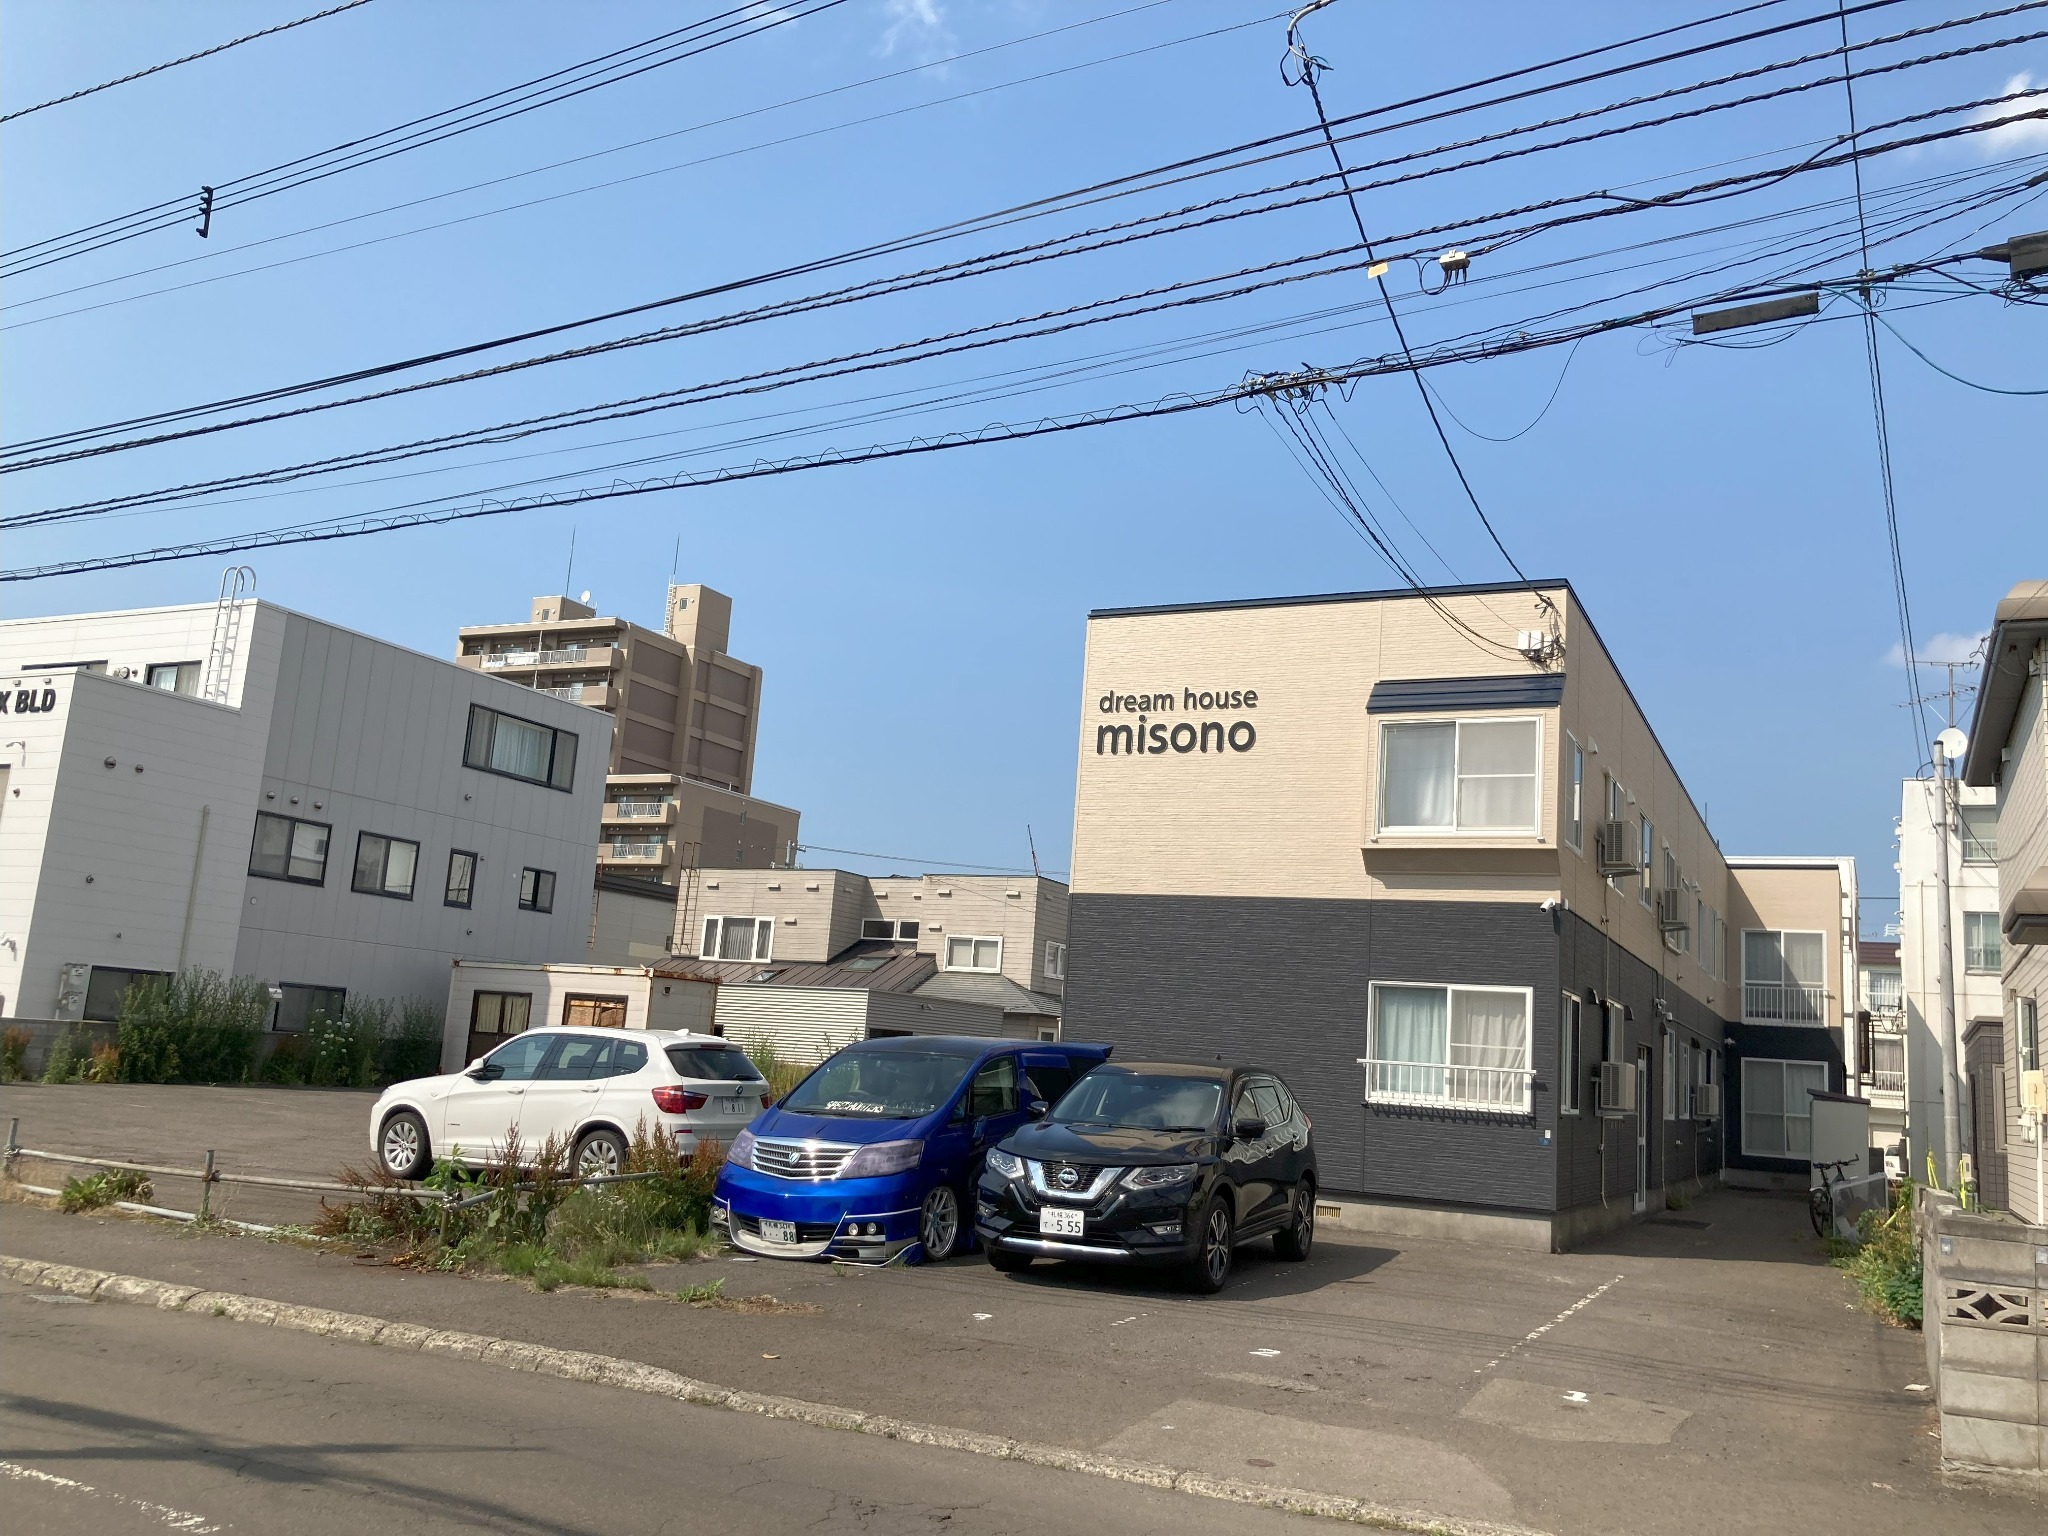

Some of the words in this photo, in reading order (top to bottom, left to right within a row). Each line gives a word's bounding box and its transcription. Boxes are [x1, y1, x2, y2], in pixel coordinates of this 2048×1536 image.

[14, 688, 57, 714] BLD
[1099, 690, 1175, 713] dream
[1183, 687, 1259, 711] house
[1096, 714, 1257, 755] misono
